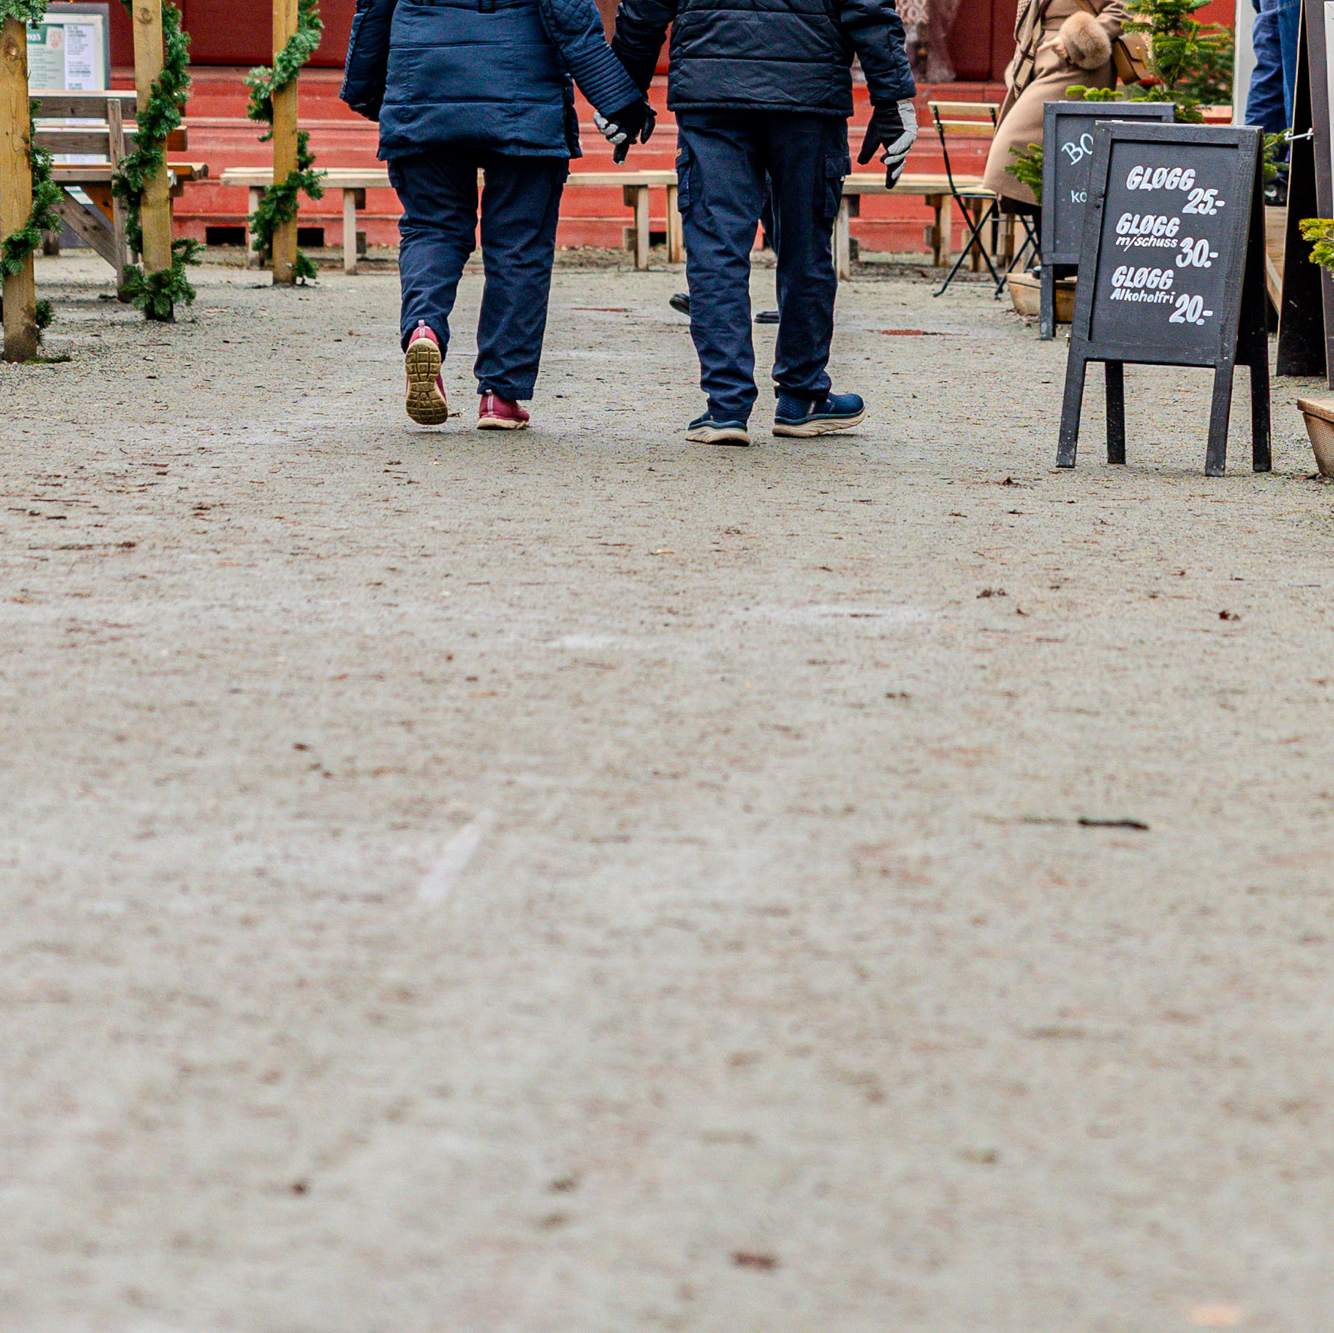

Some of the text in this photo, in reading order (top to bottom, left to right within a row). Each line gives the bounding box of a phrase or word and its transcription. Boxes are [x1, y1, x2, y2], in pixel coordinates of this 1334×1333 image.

[1126, 165, 1196, 191] GLØGG
[1182, 187, 1225, 215] 25.-
[1115, 213, 1181, 237] GLØGG
[1115, 233, 1179, 252] m/schuss
[1175, 237, 1219, 268] 30.-
[1111, 265, 1175, 290] GLØGG
[1110, 288, 1176, 304] Alkoholfri
[1169, 294, 1213, 326] 20.-
